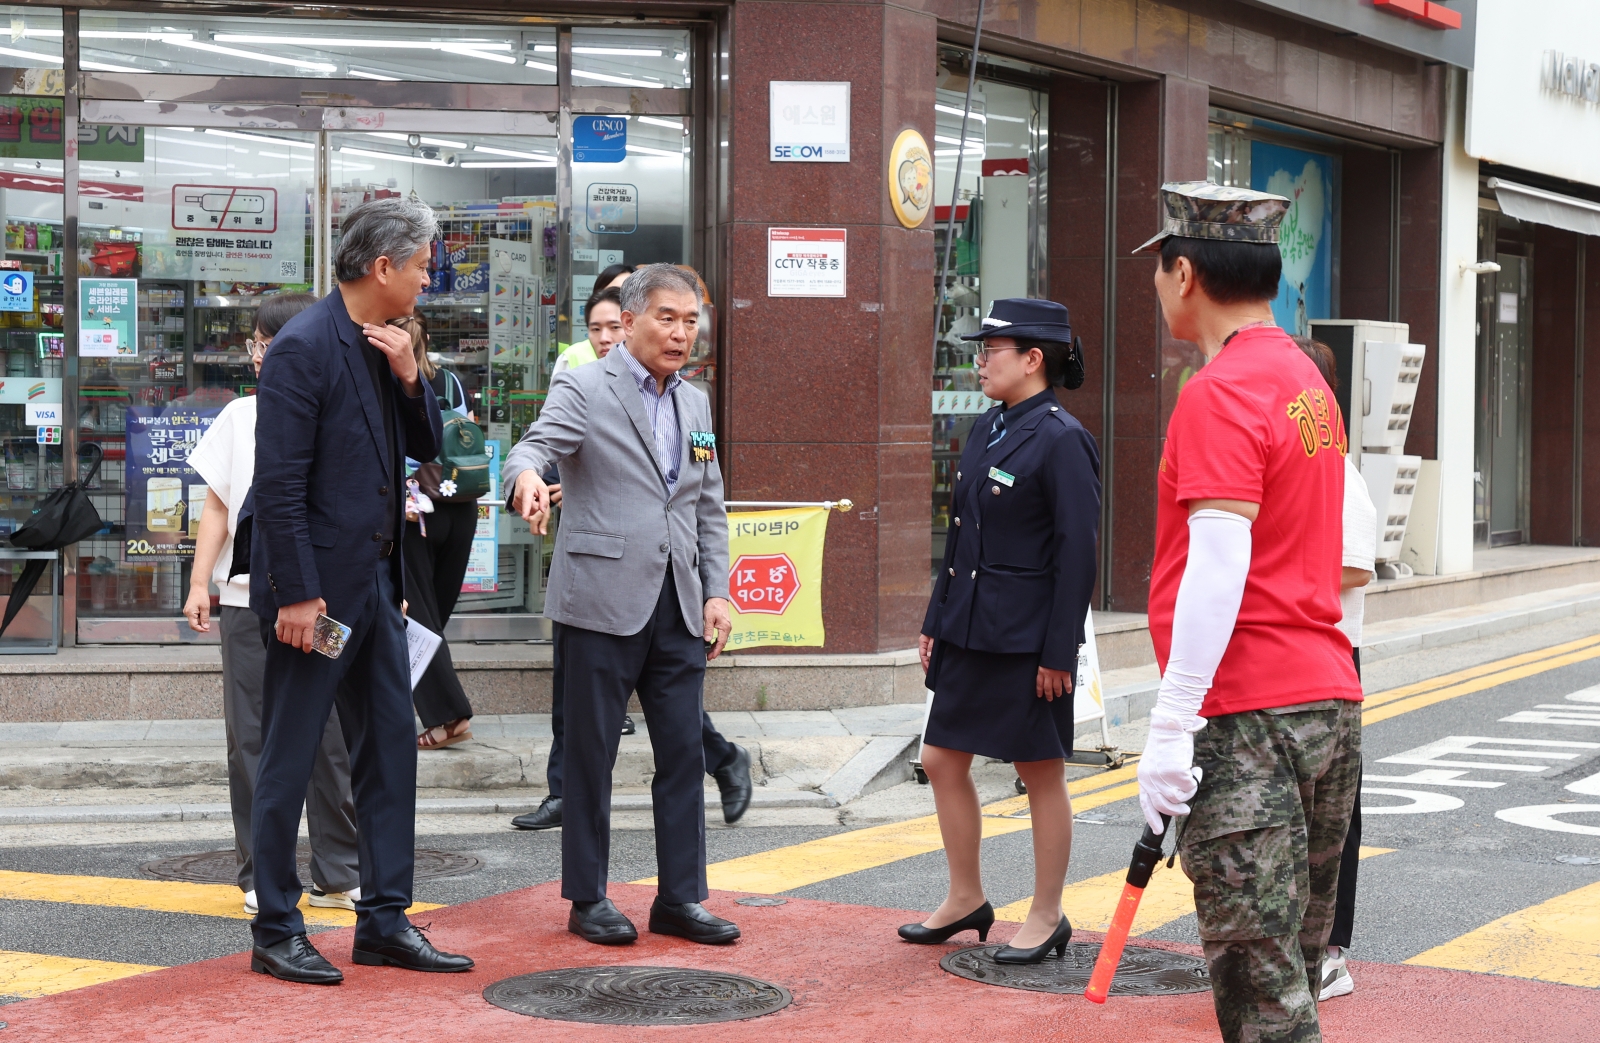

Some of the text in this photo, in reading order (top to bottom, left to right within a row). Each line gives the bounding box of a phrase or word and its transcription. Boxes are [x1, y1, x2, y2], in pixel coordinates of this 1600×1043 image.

[783, 105, 836, 126] 에스원
[592, 120, 623, 131] CESCO
[775, 146, 822, 158] SECOM
[176, 237, 272, 249] 괜찮은 담배는 없습니다
[511, 253, 527, 262] CARD
[775, 259, 840, 270] CCTV 작동중
[88, 288, 128, 296] 세븐일레븐
[88, 296, 128, 305] 온라인주문
[97, 305, 120, 313] 서비스
[38, 427, 60, 442] JCB
[127, 540, 156, 554] 20%
